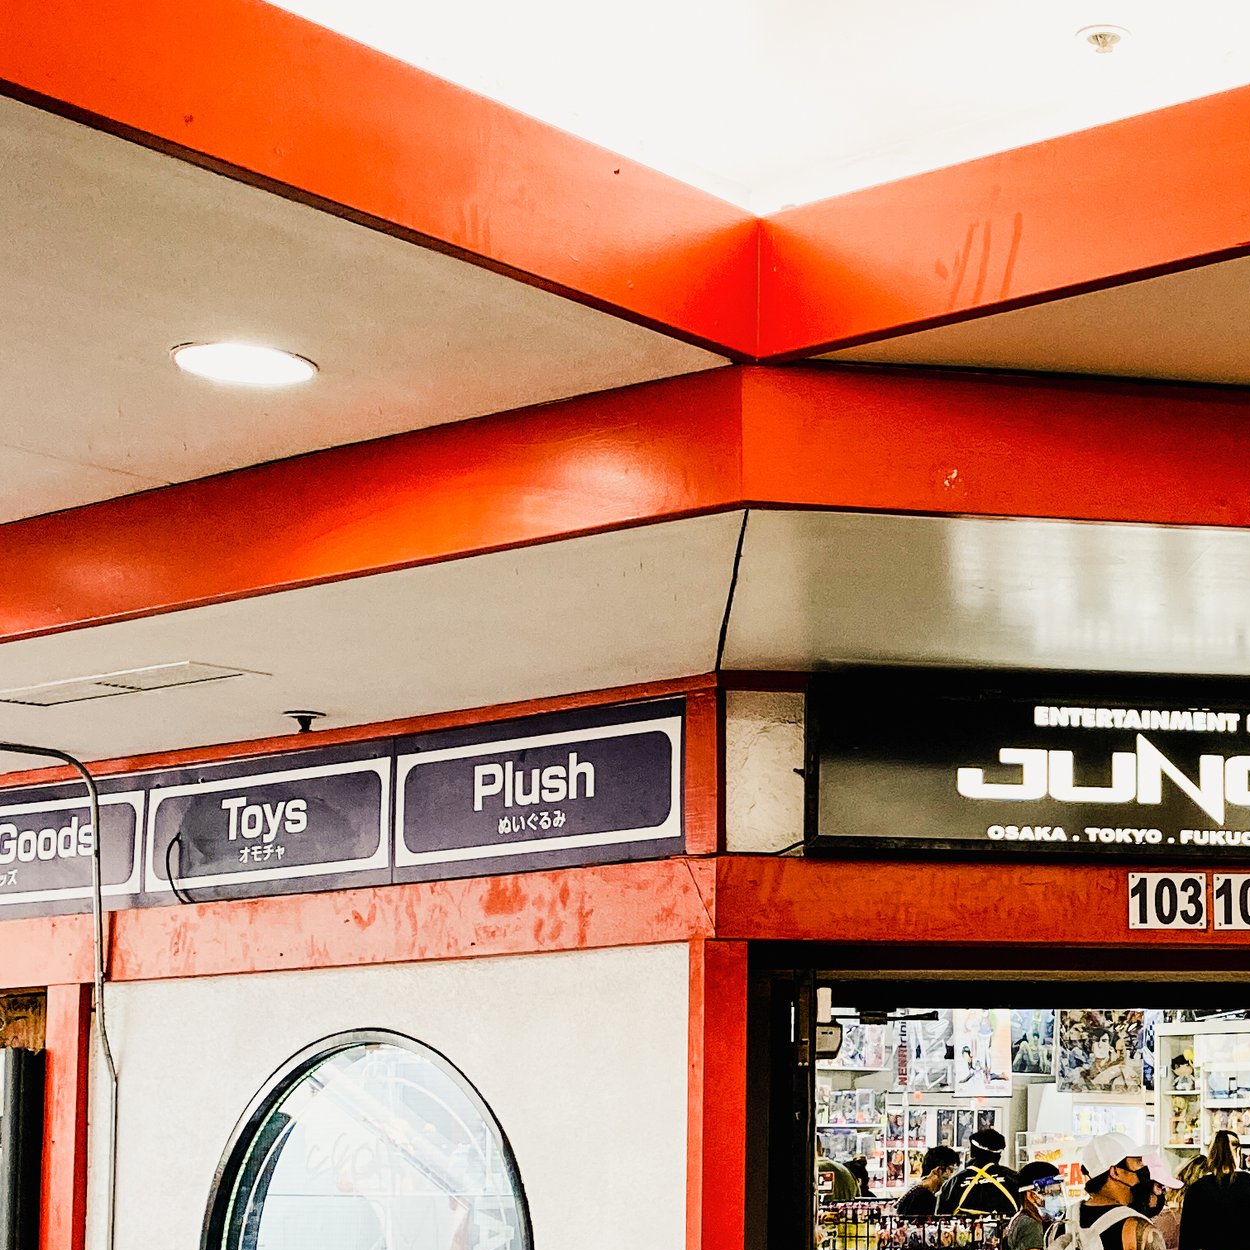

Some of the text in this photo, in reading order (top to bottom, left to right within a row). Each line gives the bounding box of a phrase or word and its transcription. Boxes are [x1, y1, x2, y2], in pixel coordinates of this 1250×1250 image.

[1034, 706, 1240, 732] ENTERTAINMENT
[474, 752, 594, 811] Plush
[222, 797, 307, 843] Toys
[498, 810, 566, 834] ぬいぐるみ
[987, 826, 1067, 841] OSAKA
[1085, 828, 1162, 844] TOKYO
[240, 845, 285, 863] オモチャ
[1131, 878, 1203, 924] 103
